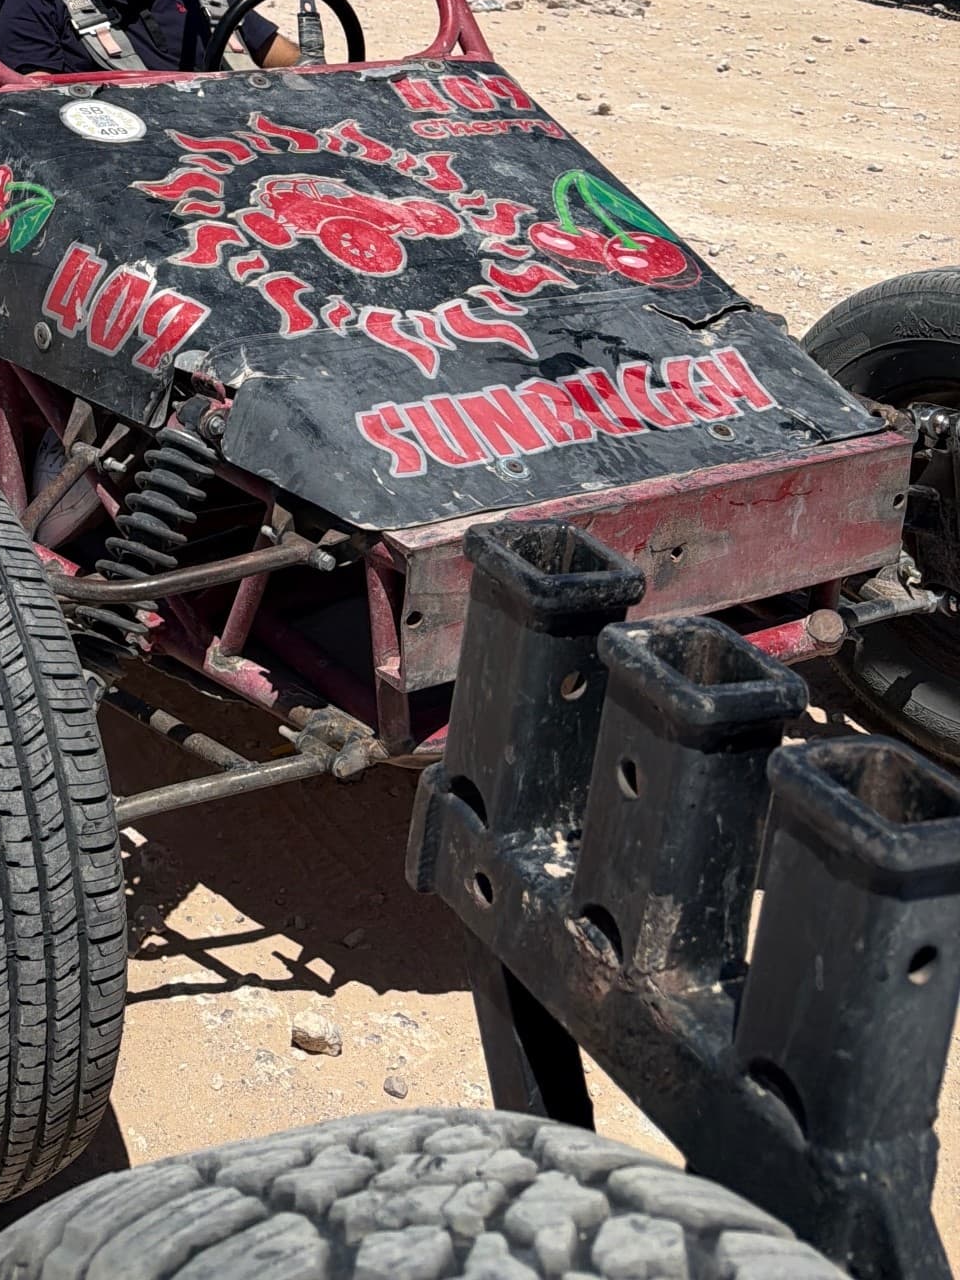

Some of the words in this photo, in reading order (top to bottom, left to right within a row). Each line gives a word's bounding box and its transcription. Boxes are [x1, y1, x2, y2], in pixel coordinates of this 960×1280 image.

[389, 72, 533, 113] 409
[80, 106, 103, 114] SB
[100, 127, 128, 136] 409
[411, 119, 568, 139] Cherry
[42, 240, 210, 371] 409
[356, 347, 778, 477] SUNBUGGY
